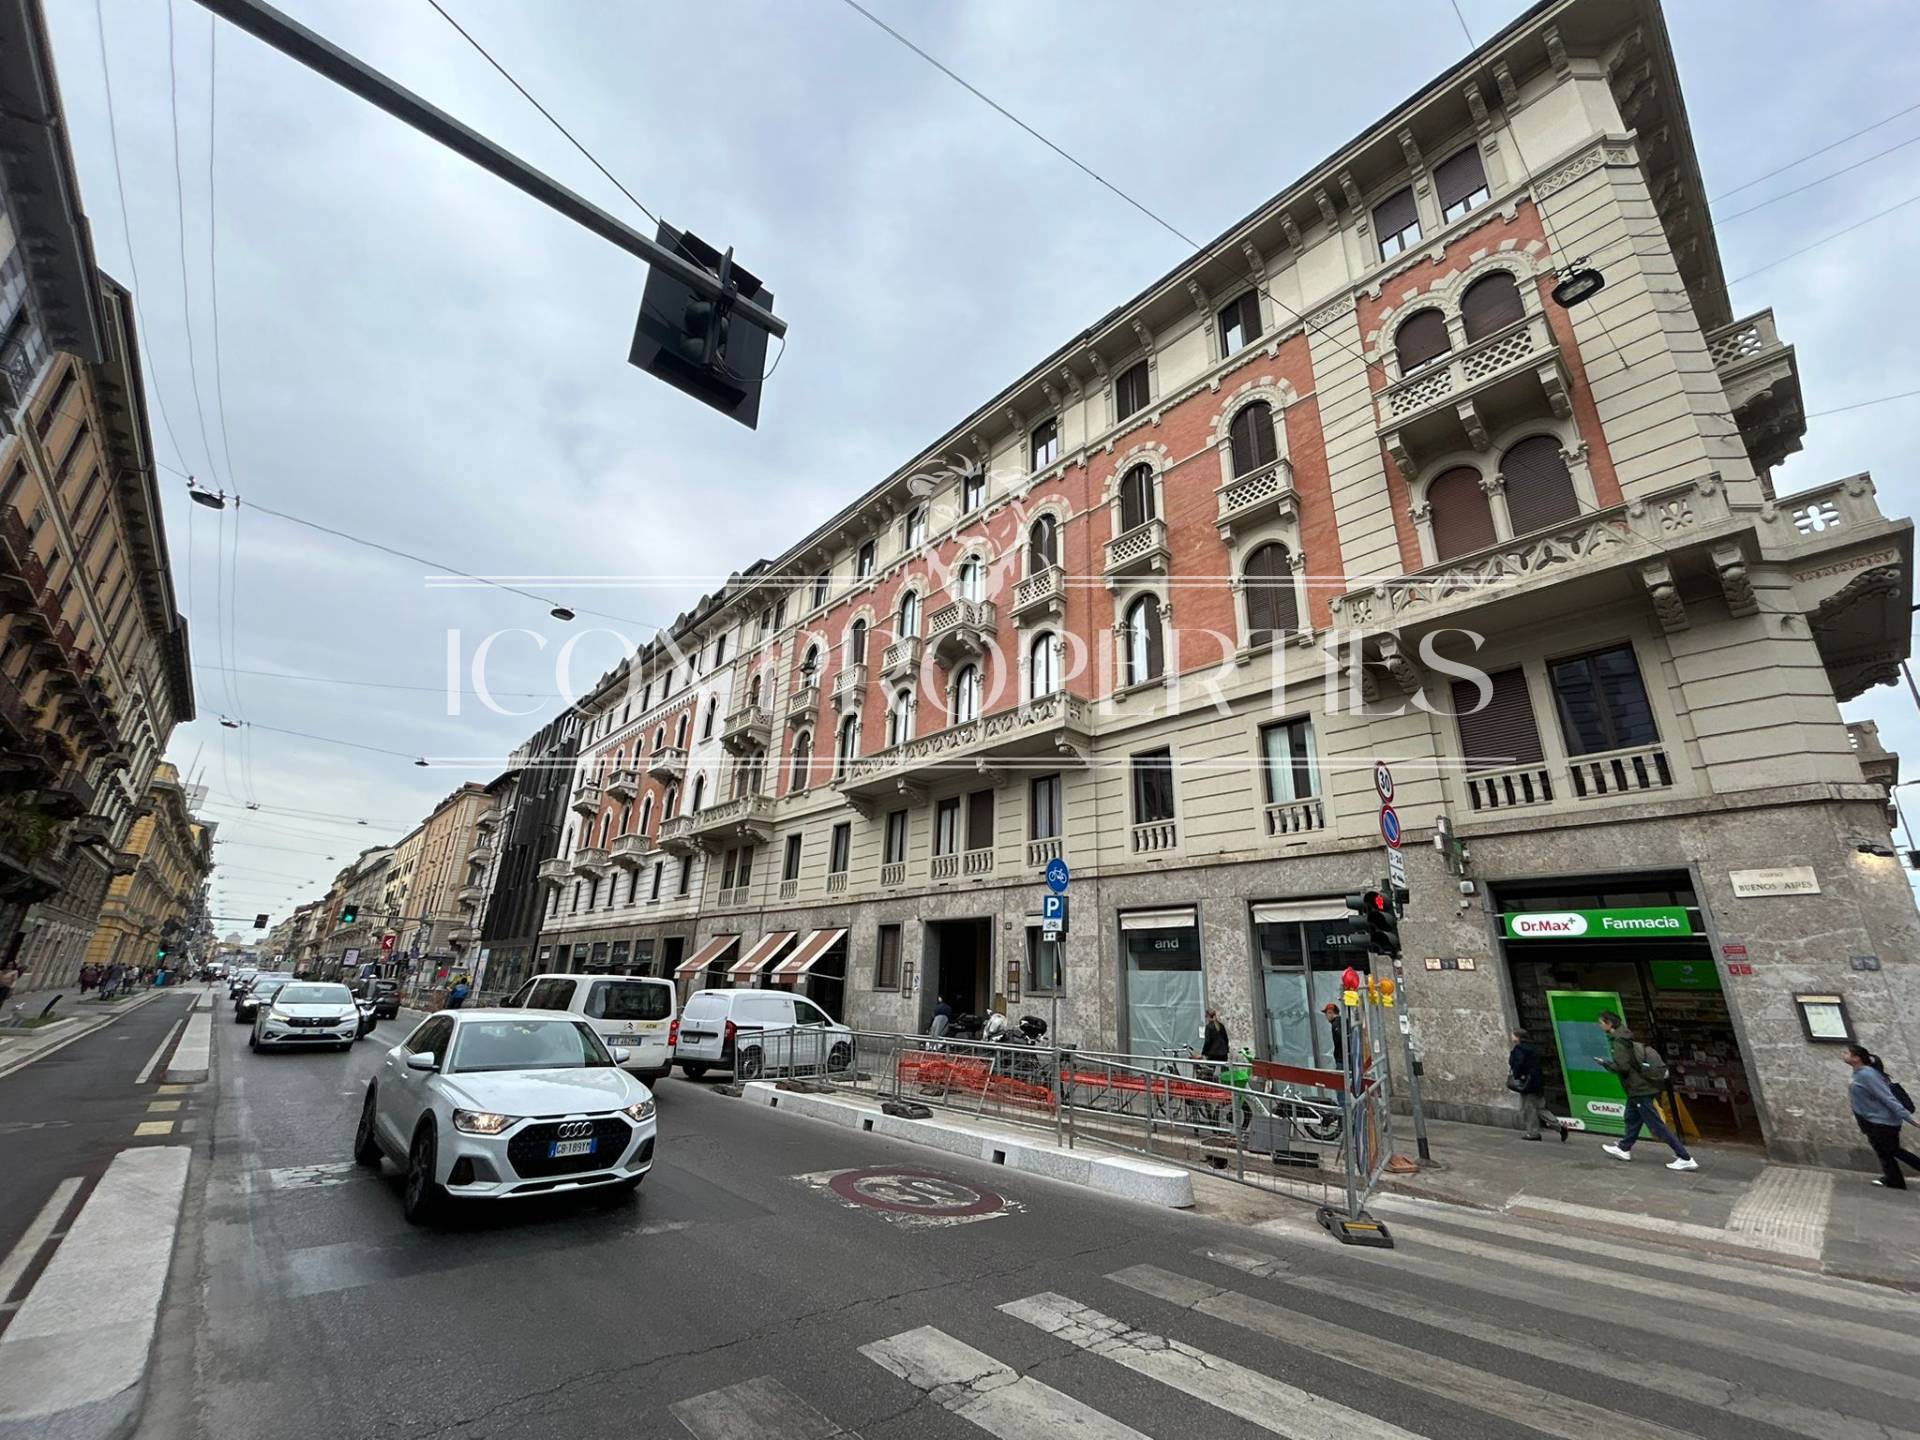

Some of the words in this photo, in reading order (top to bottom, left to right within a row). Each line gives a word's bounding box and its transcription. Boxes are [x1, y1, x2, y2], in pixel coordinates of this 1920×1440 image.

[1379, 771, 1391, 793] 30
[1738, 882, 1778, 892] BUENOS
[1783, 881, 1814, 890] AIRES
[1046, 897, 1060, 917] P
[1602, 915, 1680, 930] Farmacia
[1154, 937, 1179, 949] and
